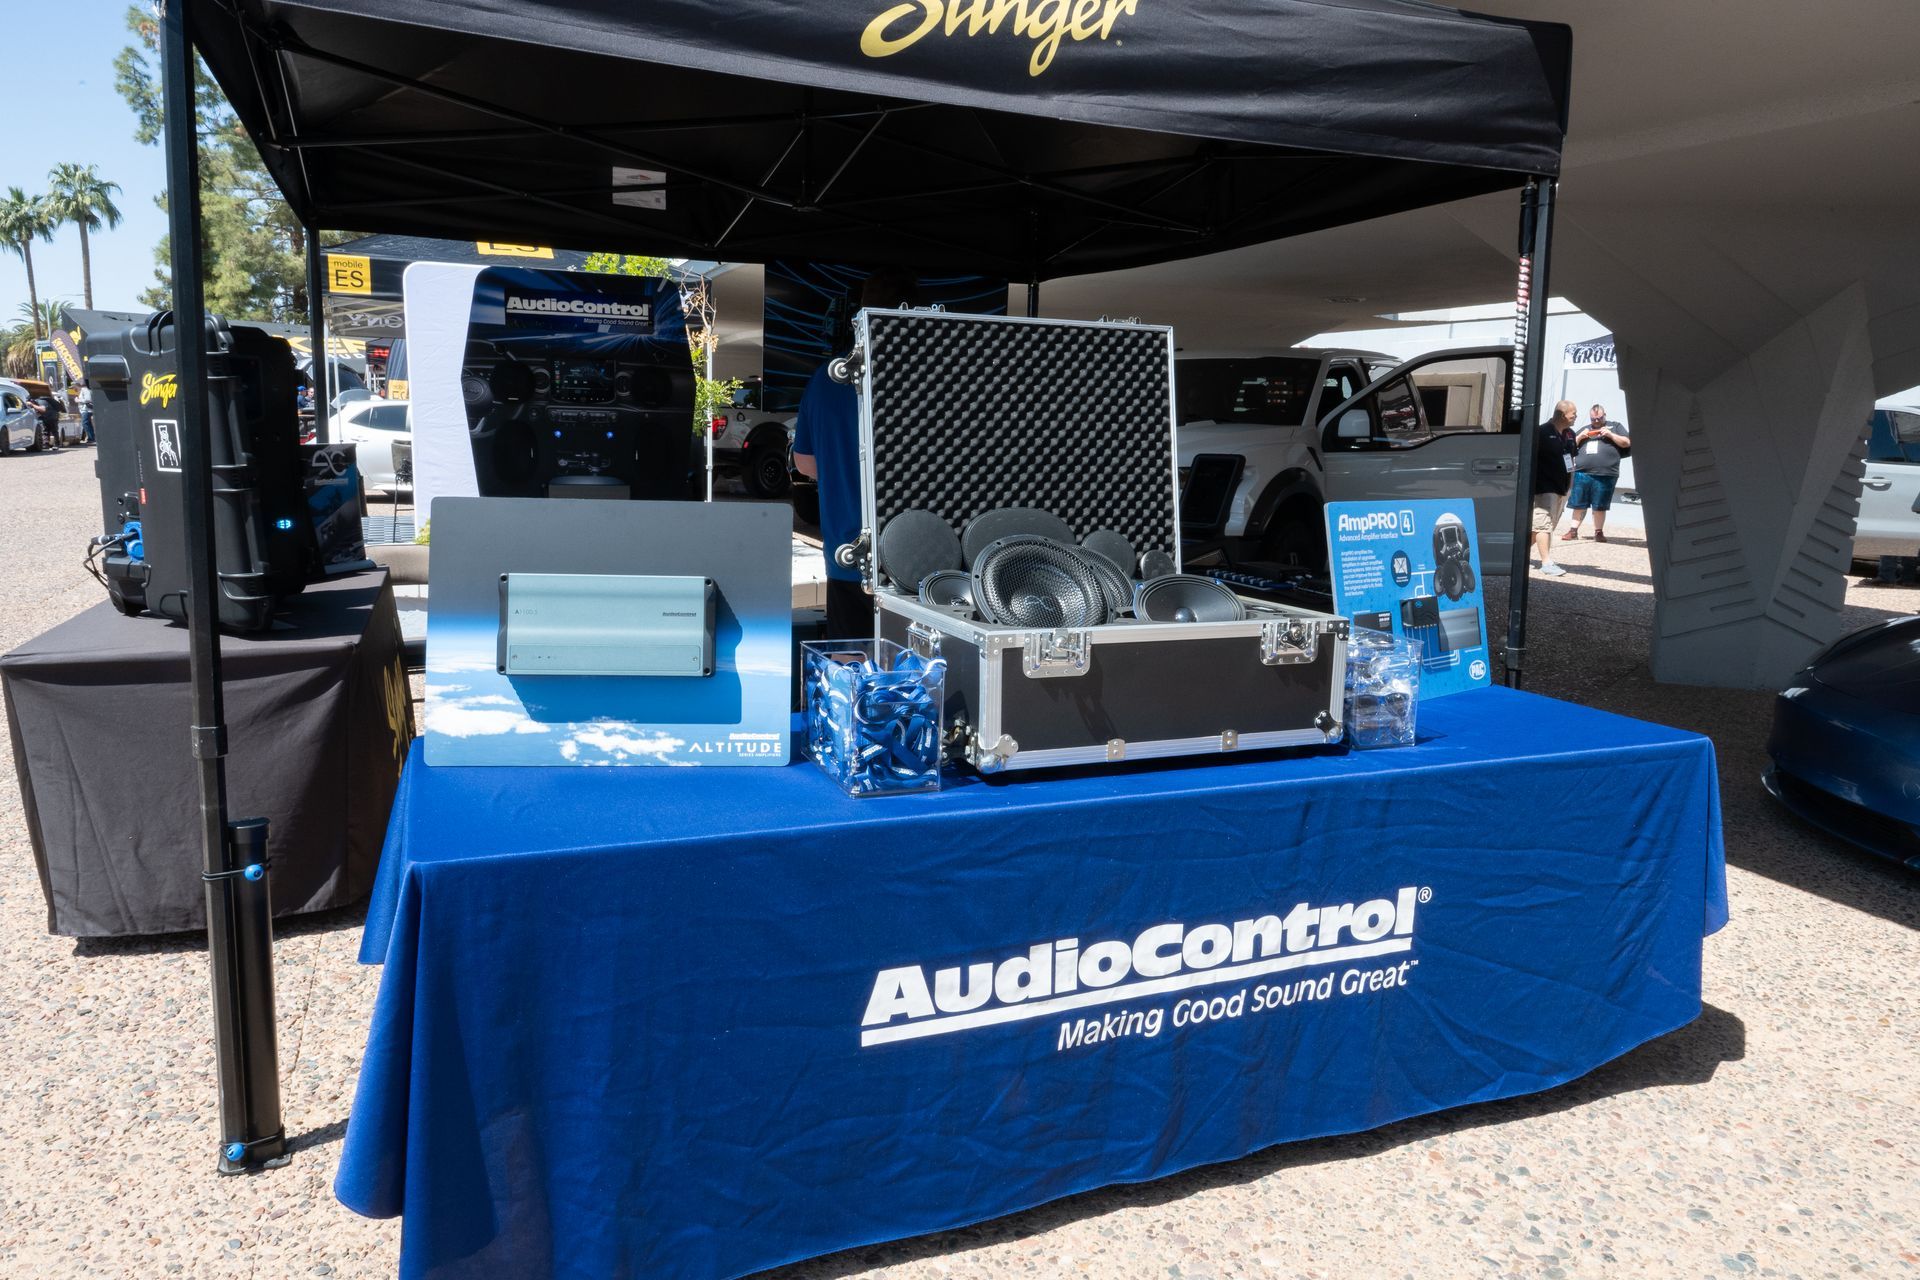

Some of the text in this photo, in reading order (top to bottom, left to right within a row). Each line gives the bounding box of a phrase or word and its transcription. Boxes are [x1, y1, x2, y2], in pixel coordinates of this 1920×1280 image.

[333, 260, 363, 269] mobile
[335, 269, 364, 288] ES
[506, 296, 649, 316] AudioControl
[57, 343, 84, 380] KICKER
[140, 372, 178, 408] Stinger
[1338, 512, 1398, 534] AmpPRO
[688, 742, 782, 753] ALTITUDE
[1057, 1009, 1162, 1051] Making
[1173, 989, 1246, 1028] Good
[1251, 976, 1333, 1013] Sound
